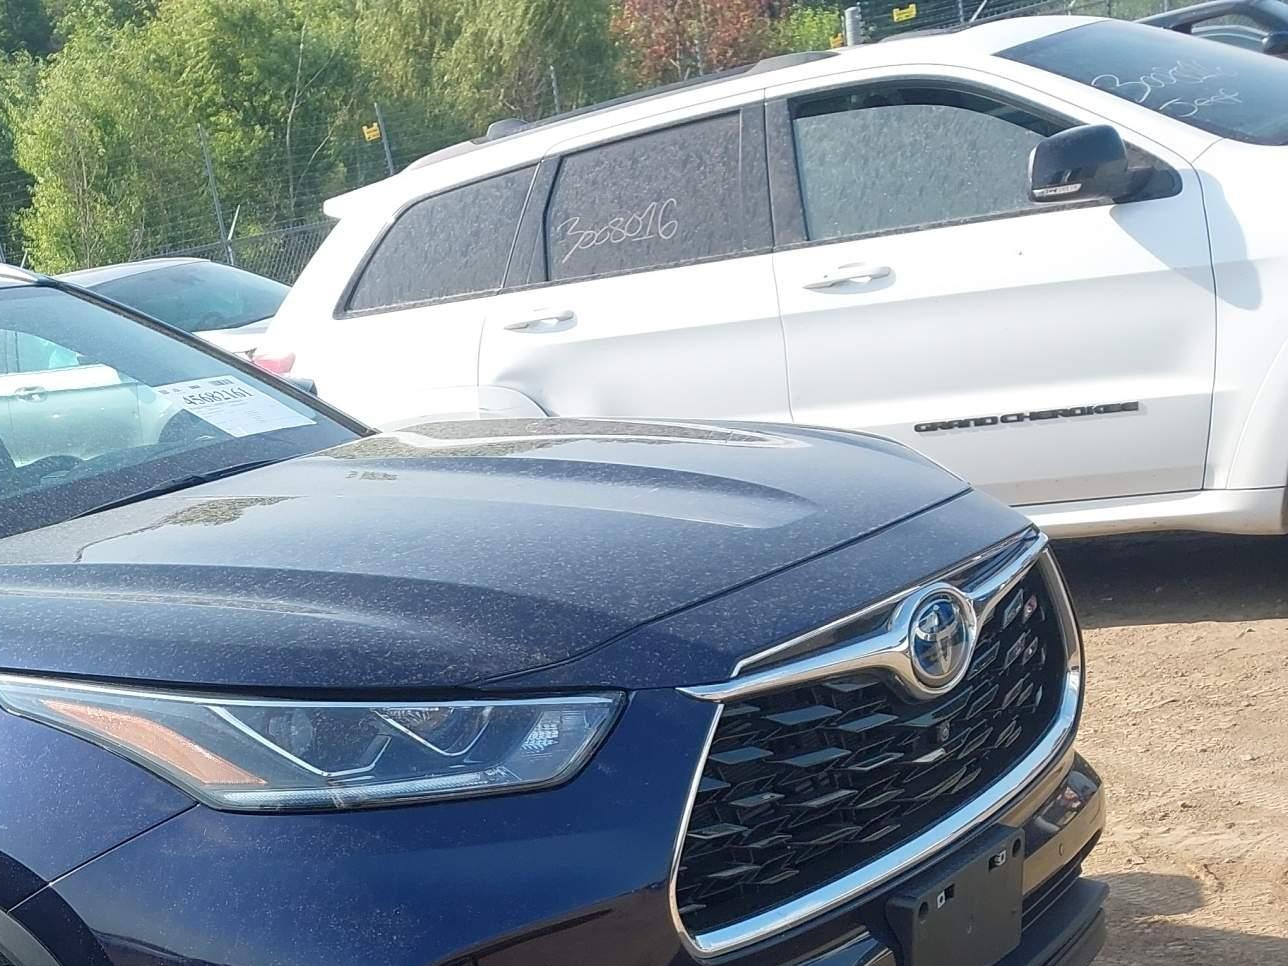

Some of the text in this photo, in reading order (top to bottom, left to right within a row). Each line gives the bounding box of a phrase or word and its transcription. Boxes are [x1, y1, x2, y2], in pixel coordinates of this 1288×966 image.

[556, 198, 678, 264] 3008016
[182, 387, 255, 406] 45682161
[914, 401, 1139, 432] GRAND CHEROKEE
